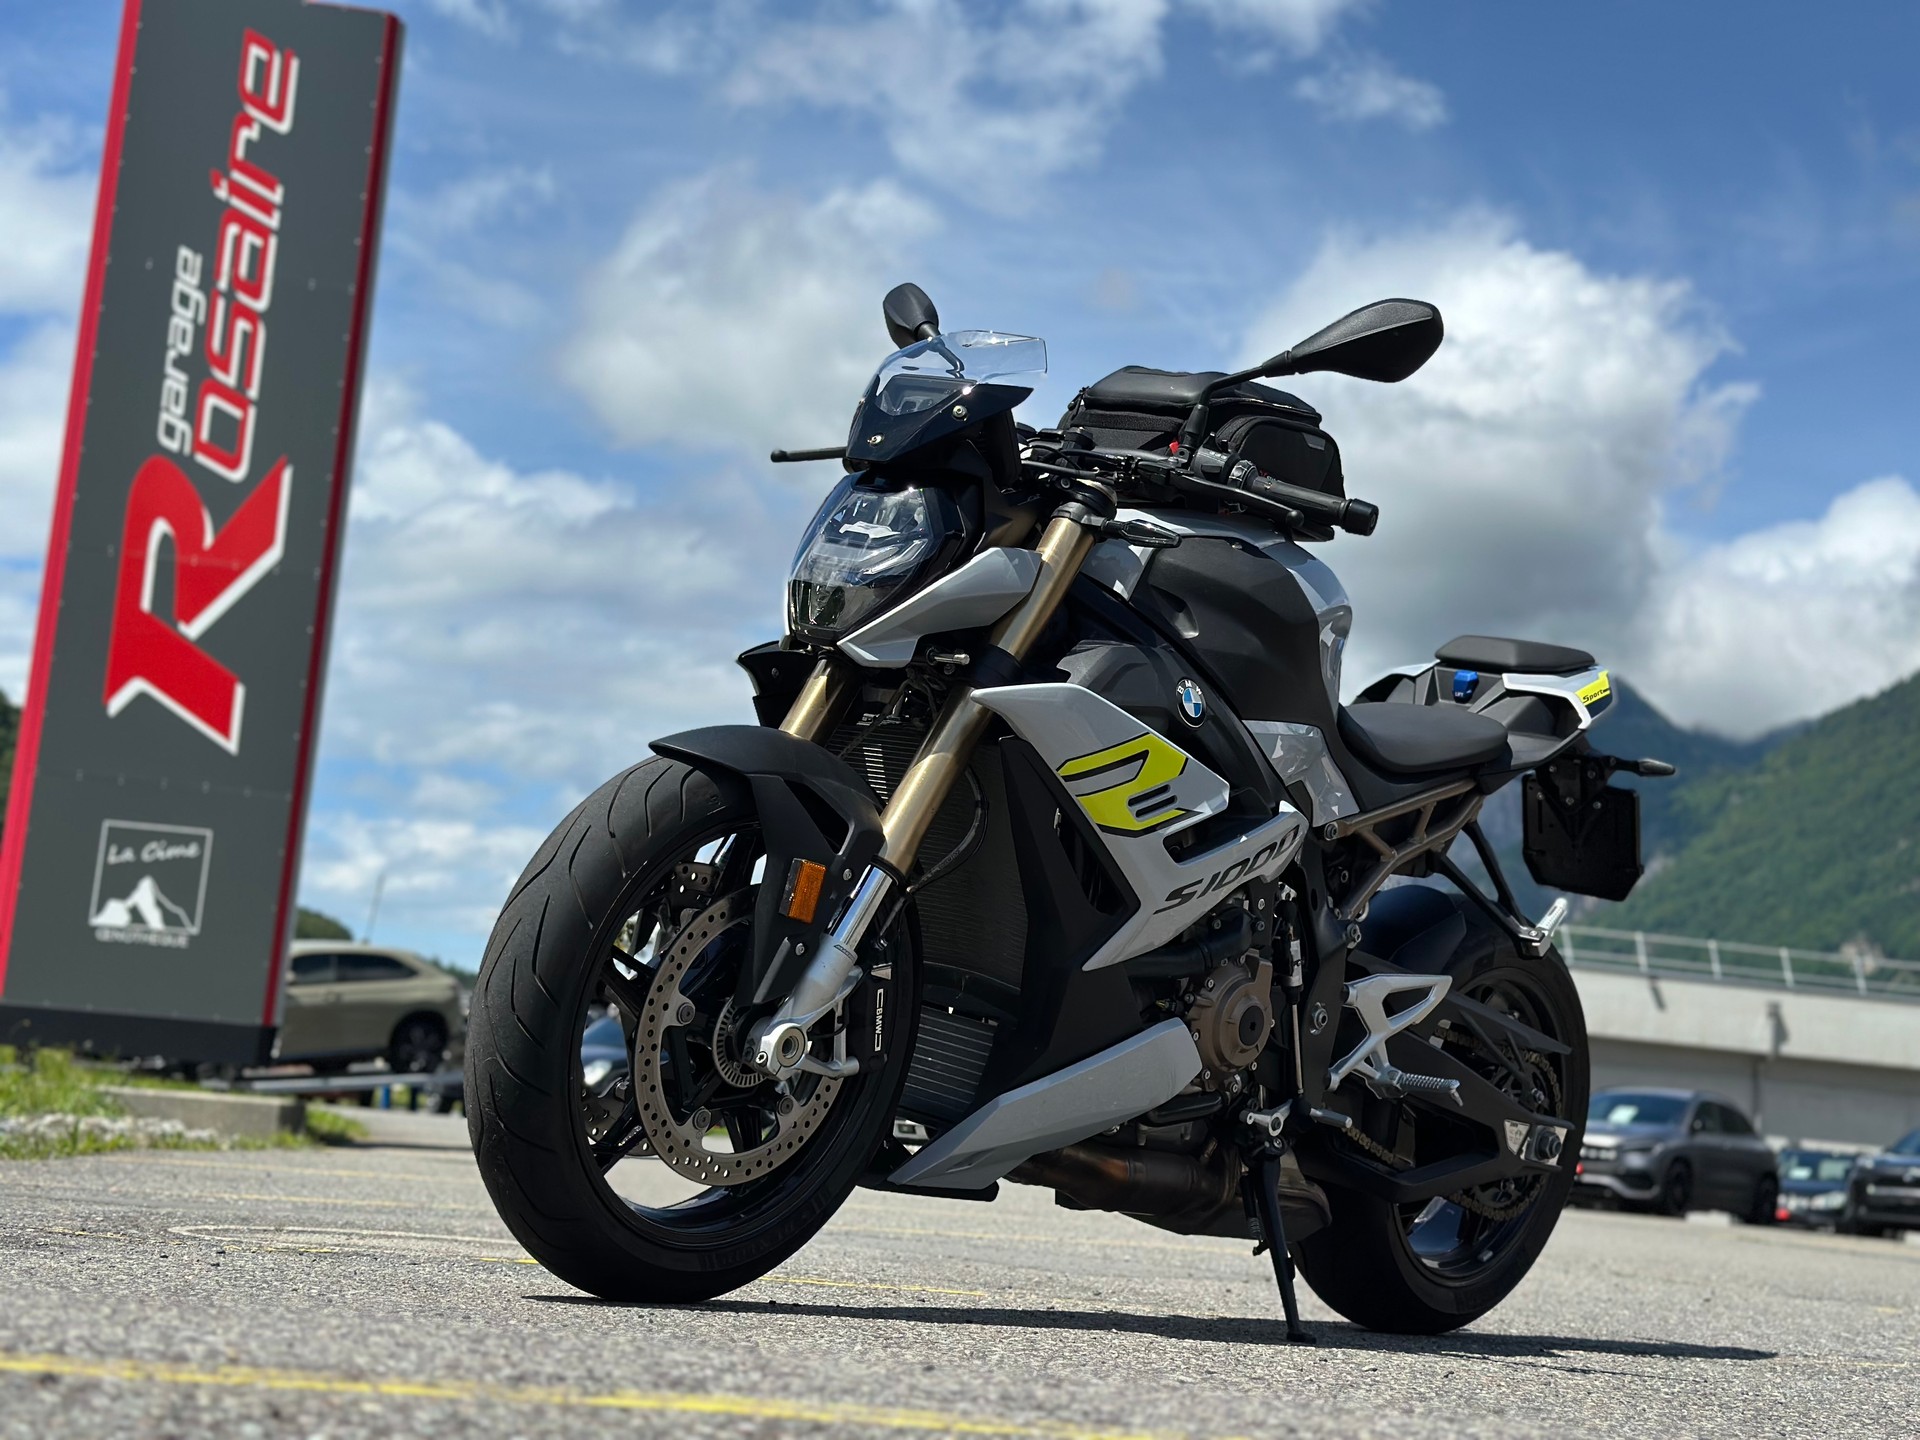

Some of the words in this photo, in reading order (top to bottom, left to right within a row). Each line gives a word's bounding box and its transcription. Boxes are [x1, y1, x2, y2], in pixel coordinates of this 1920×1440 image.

[157, 247, 206, 455] garage
[104, 29, 299, 755] Rosaire
[1177, 680, 1202, 695] BMW
[1582, 689, 1605, 703] Sport
[107, 844, 136, 865] La
[1153, 824, 1301, 915] S1000
[875, 1008, 883, 1034] BMW
